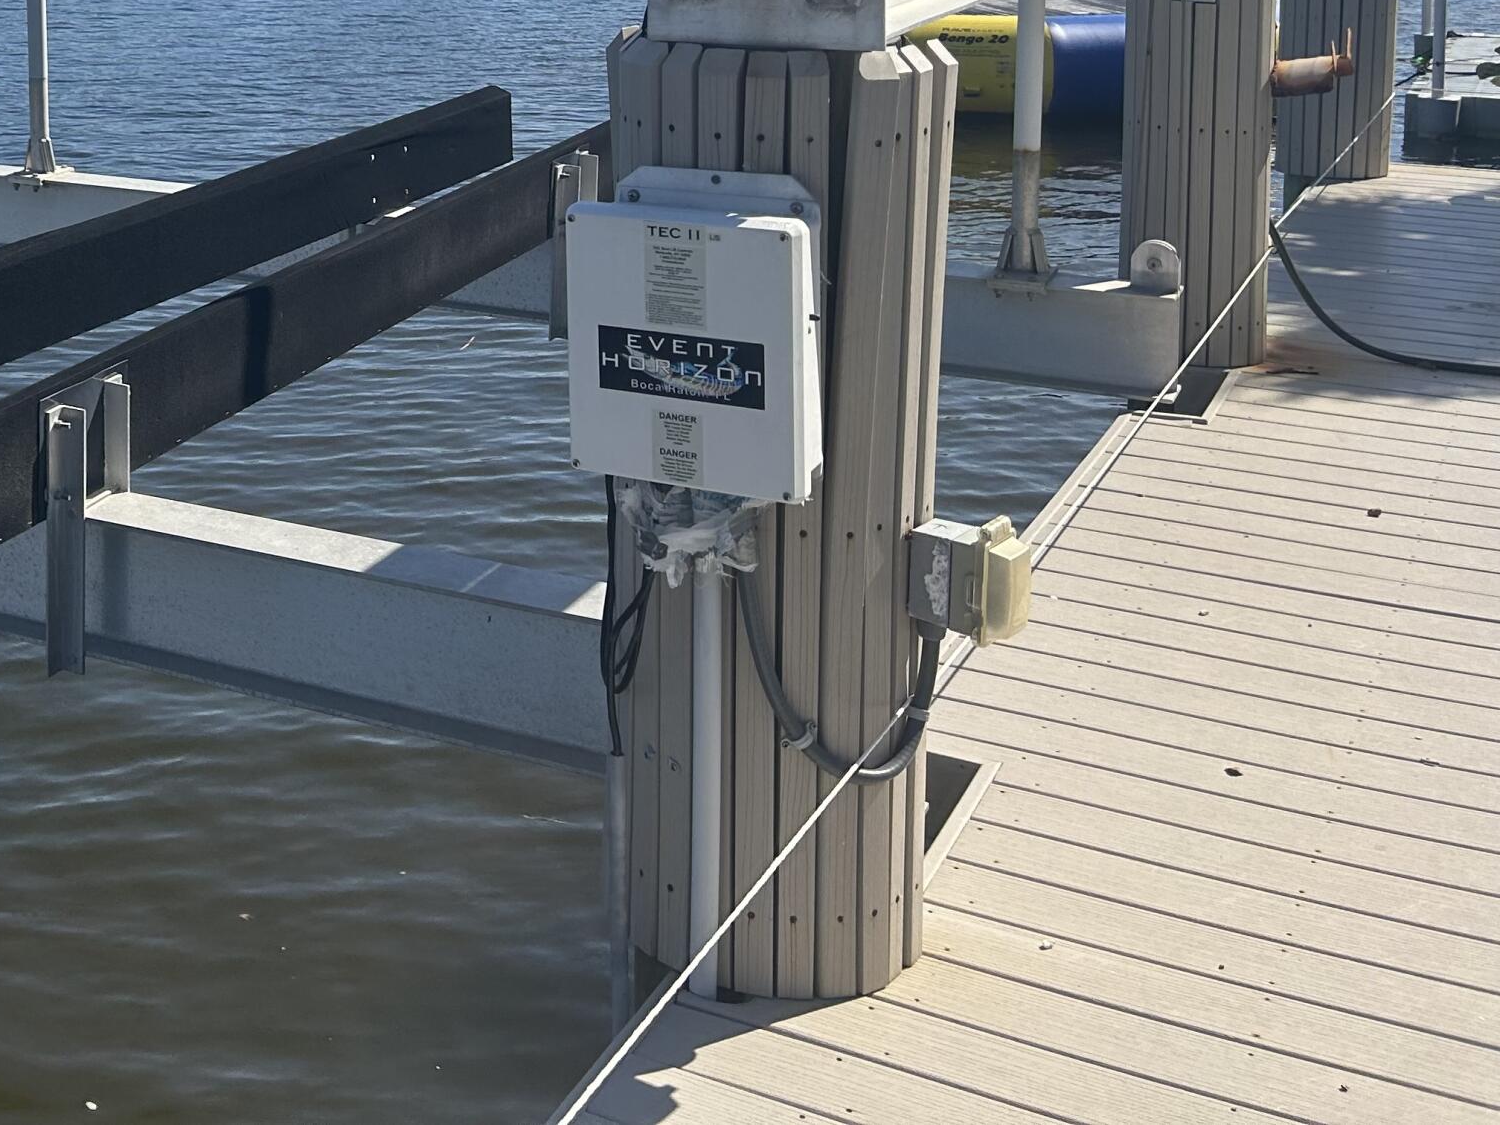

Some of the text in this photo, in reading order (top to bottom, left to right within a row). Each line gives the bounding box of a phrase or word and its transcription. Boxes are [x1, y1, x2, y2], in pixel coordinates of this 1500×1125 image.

[988, 34, 1010, 44] 20
[647, 225, 700, 241] TEC II
[630, 378, 662, 392] Boca
[659, 411, 698, 424] DANGER
[659, 447, 698, 460] DANGER
